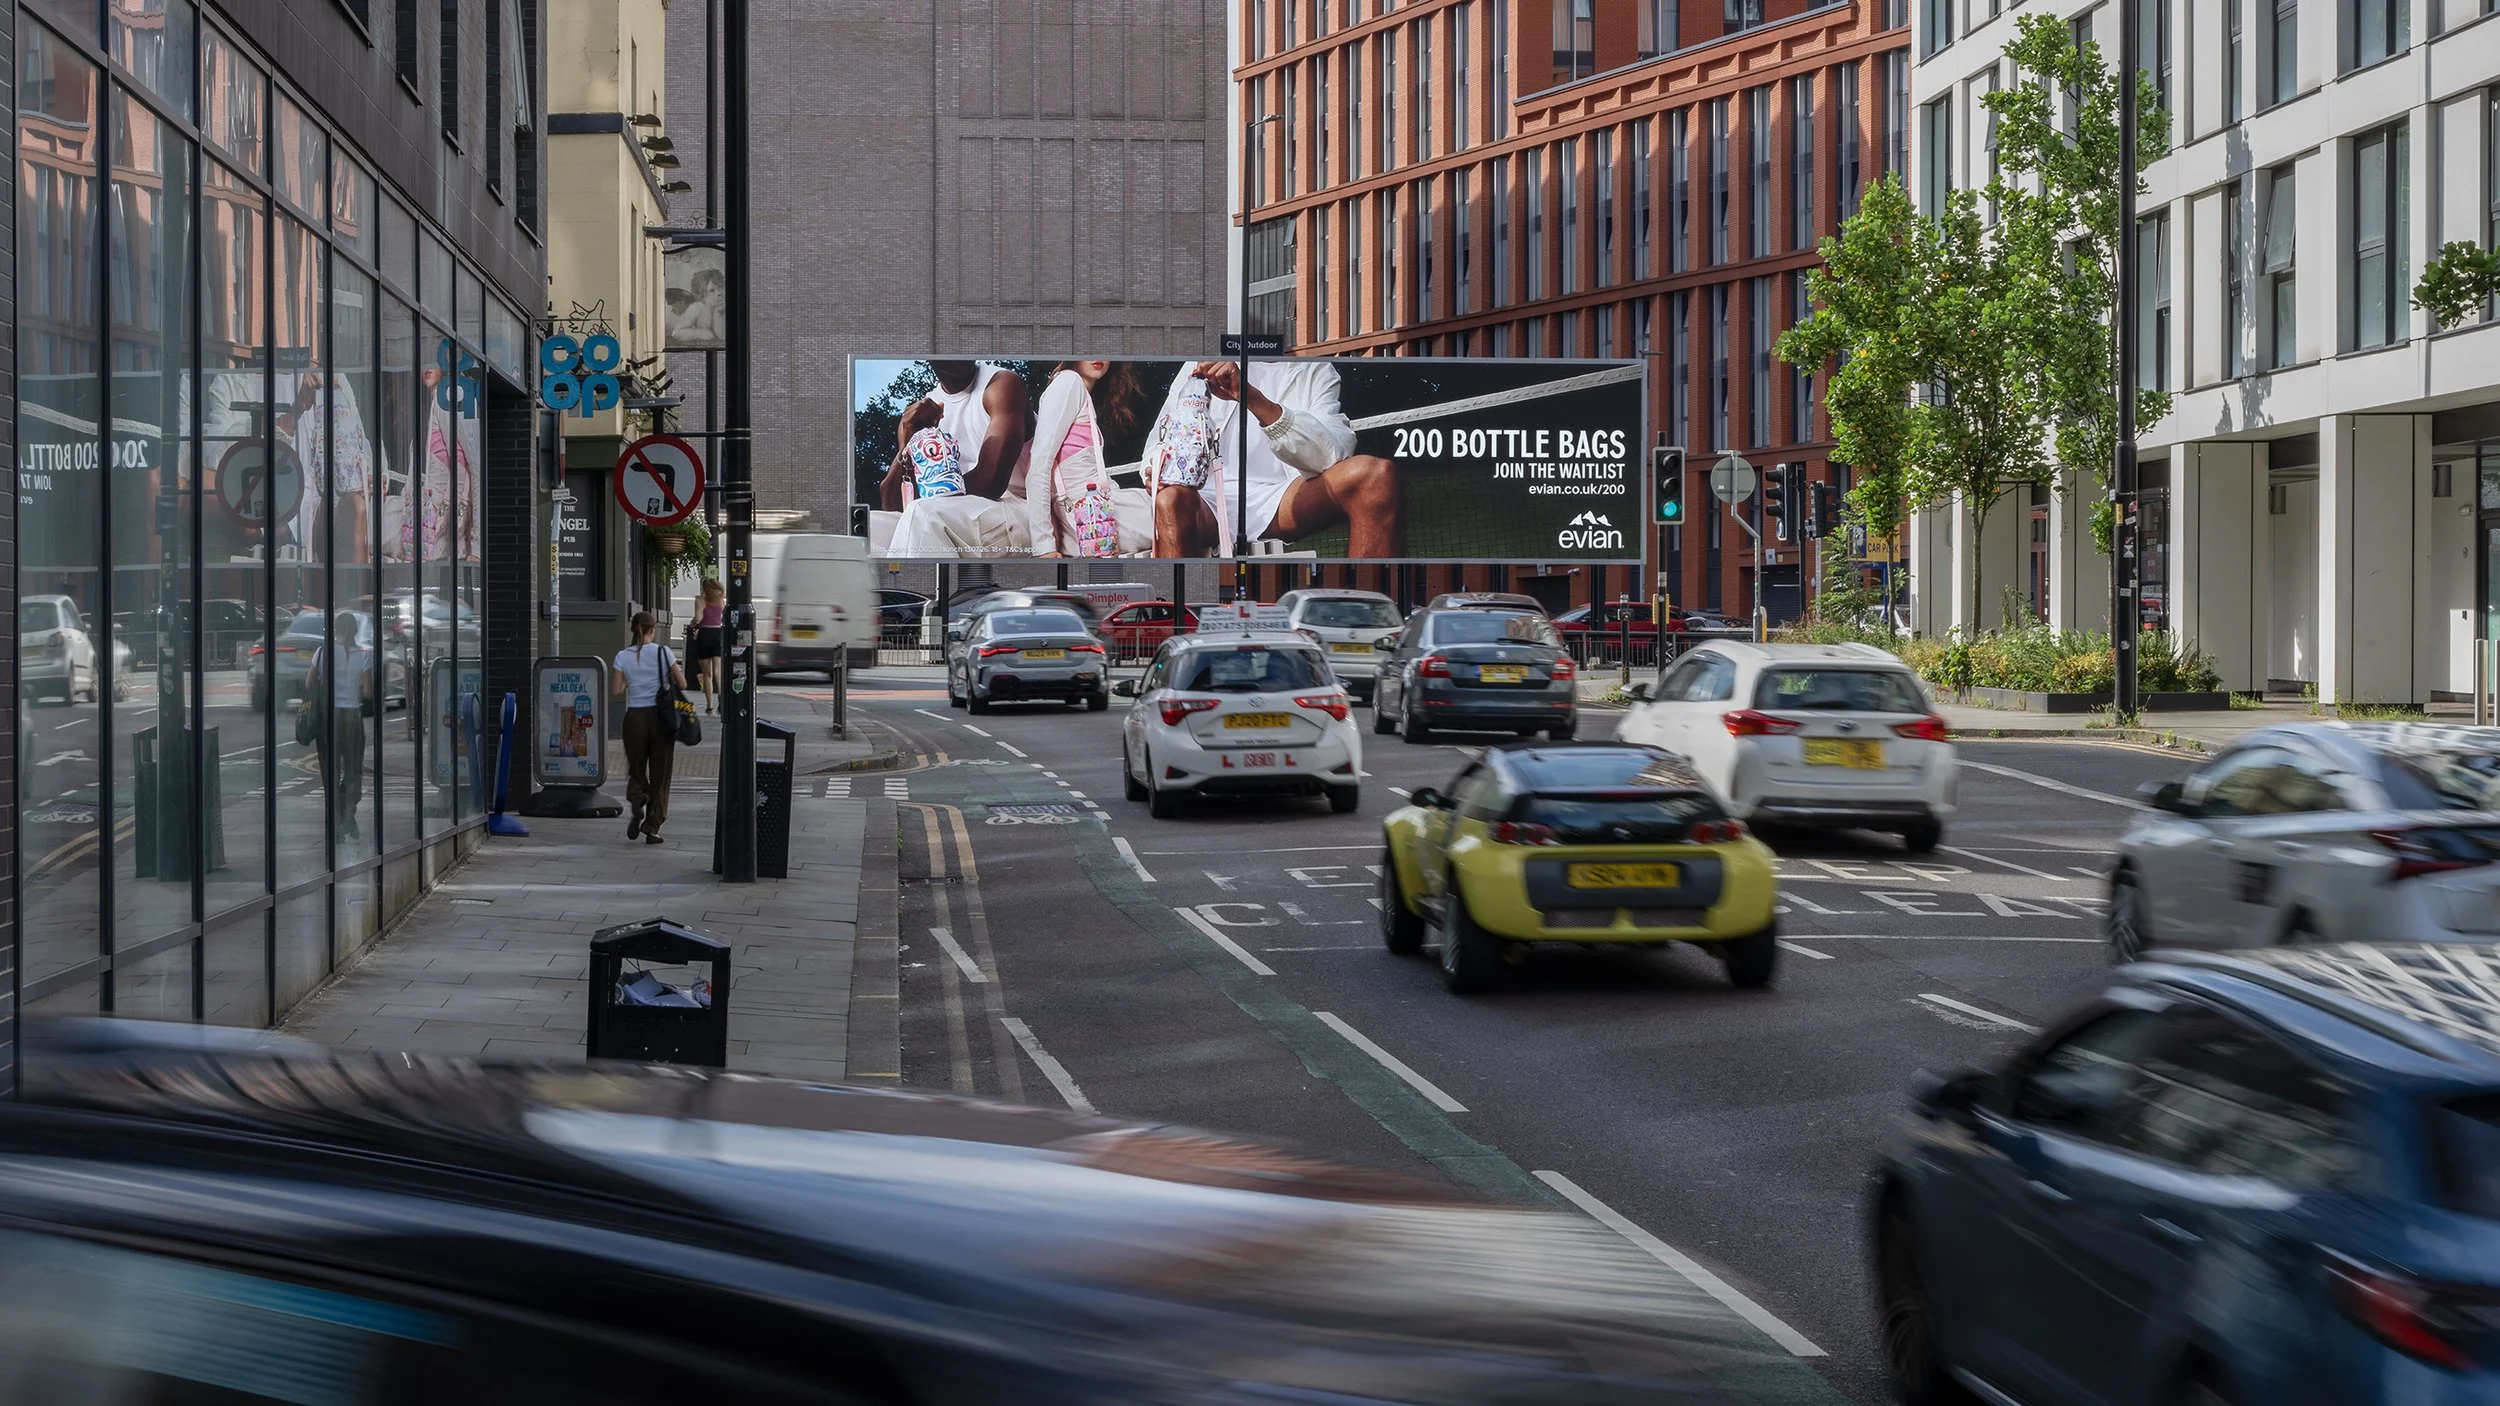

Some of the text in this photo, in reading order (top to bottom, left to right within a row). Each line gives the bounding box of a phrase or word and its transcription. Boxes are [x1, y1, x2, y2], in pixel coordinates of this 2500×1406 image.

[1226, 341, 1241, 350] City
[1183, 400, 1206, 409] evian
[1393, 428, 1626, 459] 200 BOTTLE BAGS
[1493, 462, 1625, 479] JOIN THE WAITLIST
[1528, 483, 1625, 495] evian.co.uk/200
[551, 518, 590, 531] NGEL
[1558, 526, 1624, 549] evian
[1868, 543, 1880, 552] CAR
[1088, 593, 1129, 606] Dimplex
[1239, 606, 1250, 618] L
[557, 673, 580, 683] LUNCH
[550, 683, 587, 693] MEAL DEAL
